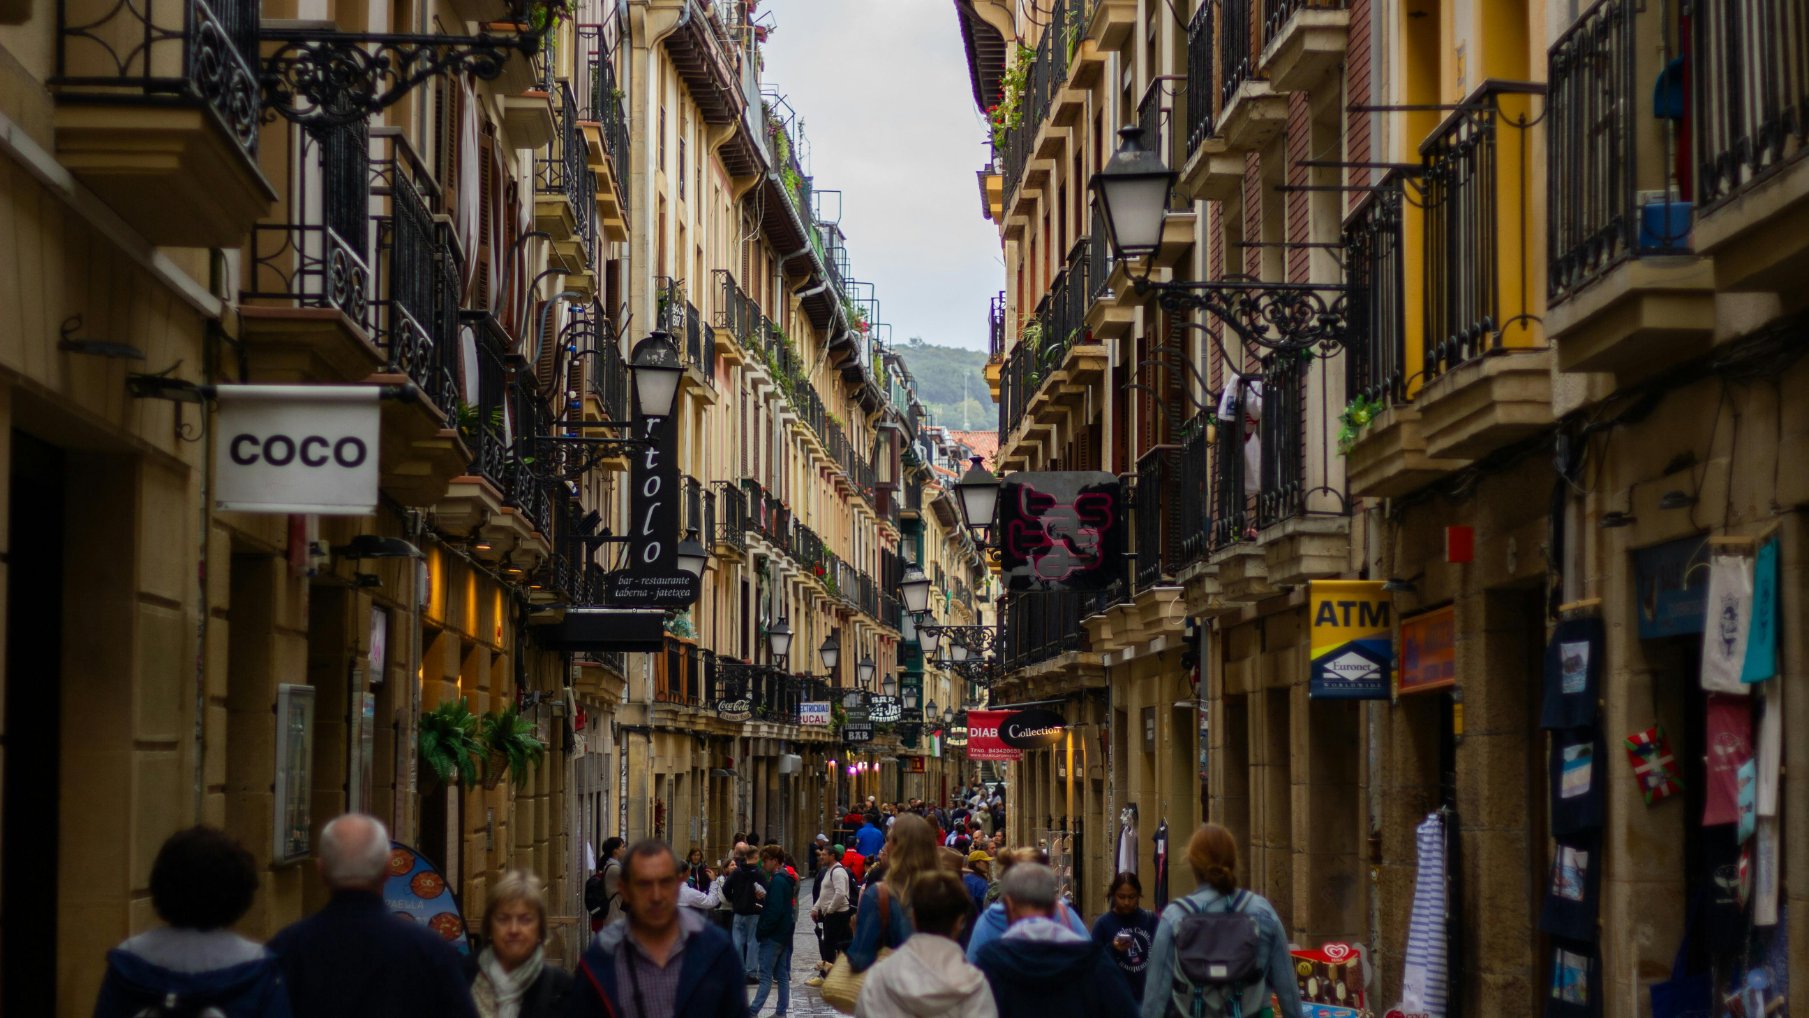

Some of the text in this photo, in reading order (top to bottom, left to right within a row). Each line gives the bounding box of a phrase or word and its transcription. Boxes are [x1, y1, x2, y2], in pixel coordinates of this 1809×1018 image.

[229, 433, 368, 469] COCO
[642, 416, 661, 564] rtolo
[618, 575, 634, 585] bar
[641, 576, 690, 585] restaurante
[615, 586, 648, 597] taberna
[654, 588, 691, 600] jatetxea
[1314, 600, 1390, 627] ATM
[1333, 661, 1371, 671] Euronet
[718, 699, 750, 712] Coca-Cola
[871, 696, 896, 704] BAR
[800, 704, 829, 713] ECTRICIDAD
[848, 731, 869, 740] BAR
[969, 727, 998, 738] DIAB
[1008, 723, 1060, 739] Collection
